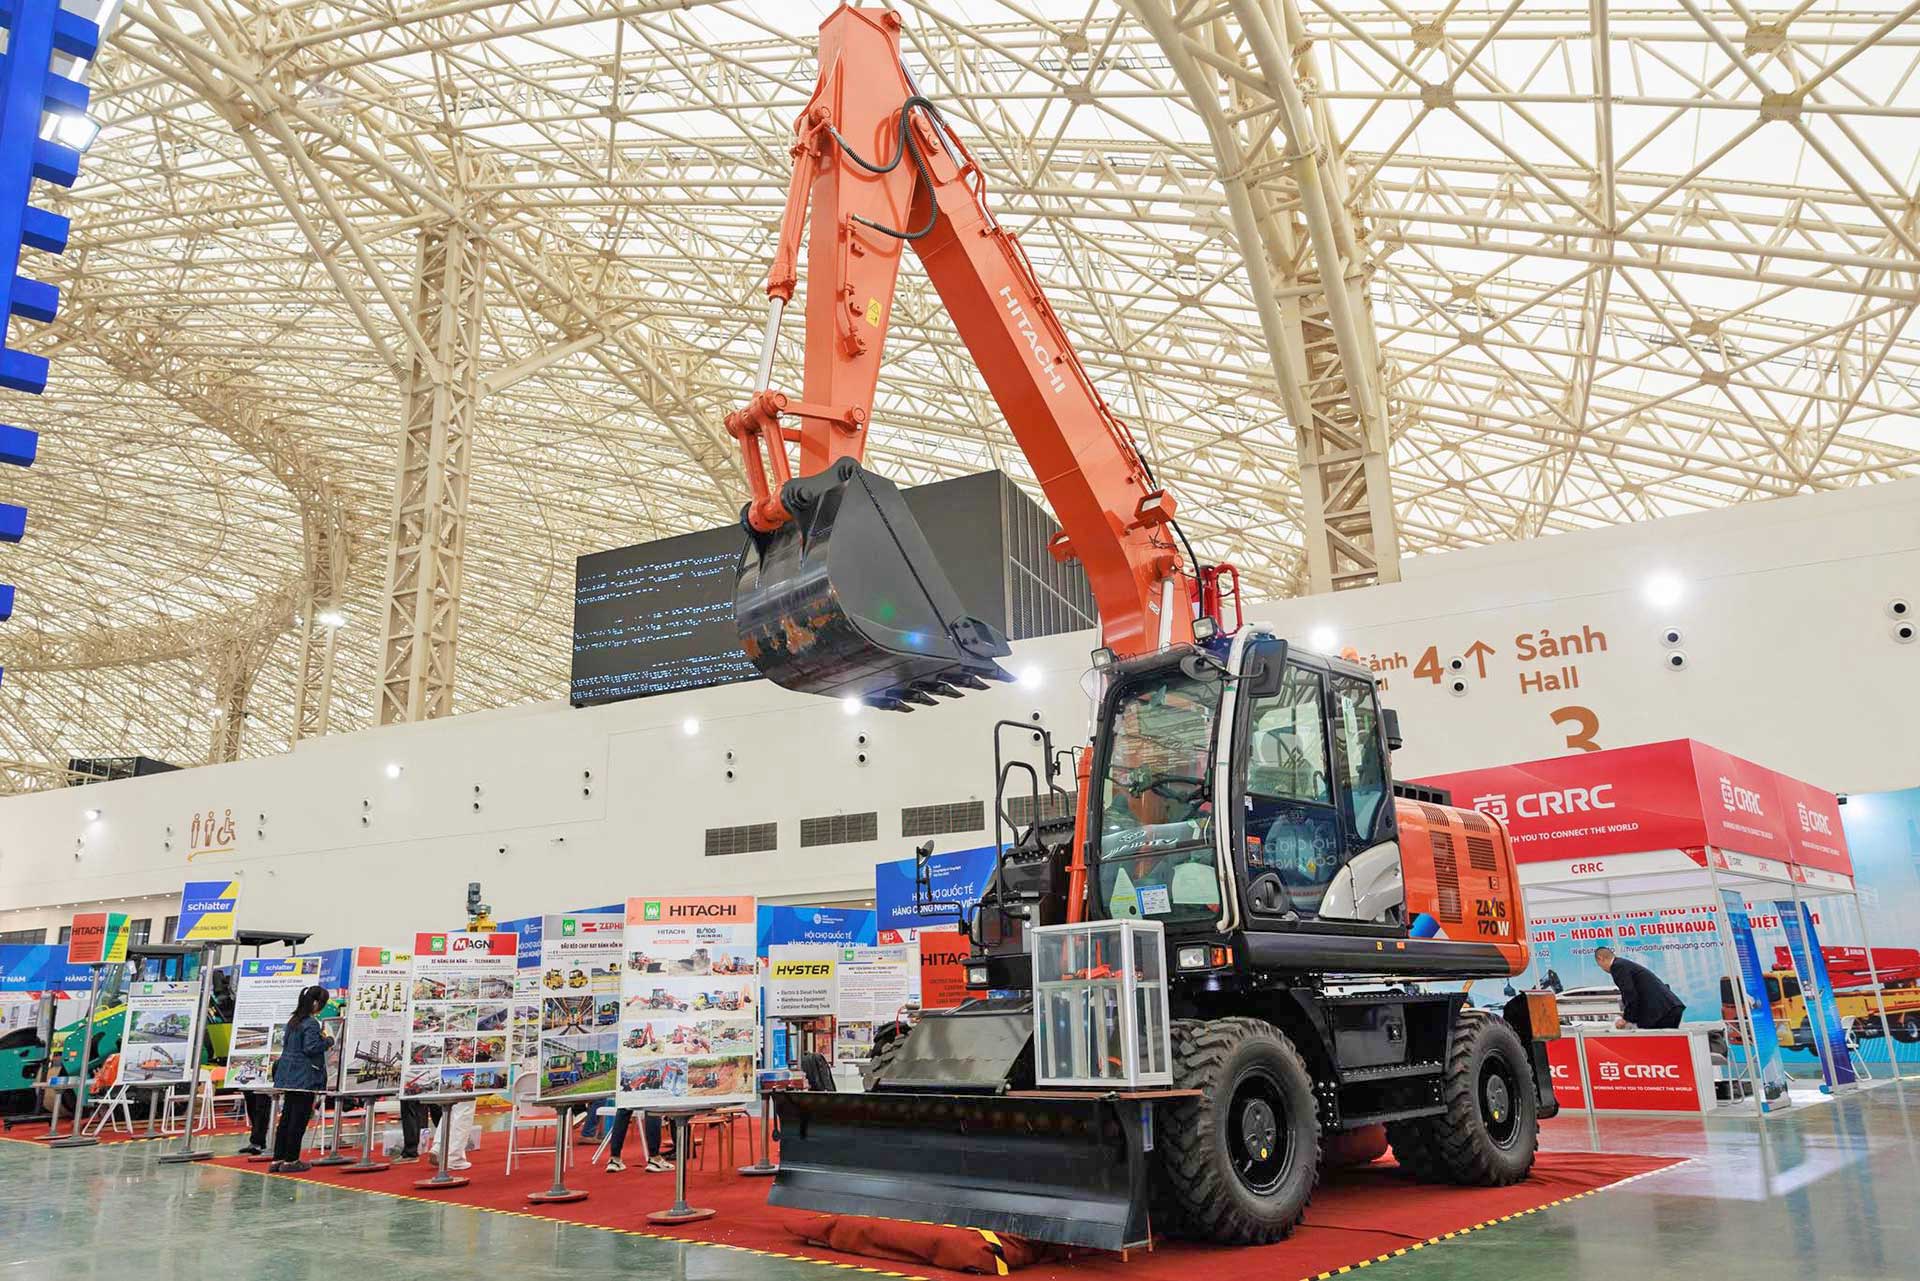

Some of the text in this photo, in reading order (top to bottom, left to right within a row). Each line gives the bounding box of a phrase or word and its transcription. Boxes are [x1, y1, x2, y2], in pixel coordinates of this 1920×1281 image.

[999, 286, 1066, 393] HITACHI
[1515, 624, 1607, 662] Sảnh
[1413, 646, 1444, 684] 4
[1519, 665, 1579, 694] Hall
[1516, 783, 1616, 818] CRRC
[1734, 786, 1764, 816] CRRC
[1521, 833, 1537, 843] YOU
[1538, 832, 1550, 841] TO
[1551, 827, 1589, 839] CONNECT
[1590, 826, 1606, 834] THE
[1607, 822, 1639, 832] WORLD
[1571, 862, 1604, 874] CRRC
[964, 882, 974, 895] TẾ
[187, 902, 230, 911] schlatter
[669, 904, 736, 917] HITACHI
[1476, 896, 1506, 917] ZAXIS
[71, 926, 104, 936] HITACHI
[1478, 920, 1510, 936] 170W
[1571, 926, 1614, 941] KHOAN
[1639, 920, 1717, 936] FURUKAWA
[453, 937, 495, 951] MAGNI
[921, 952, 969, 966] HITAC
[265, 963, 293, 971] schlatter
[776, 965, 830, 976] HYSTER
[1623, 1064, 1680, 1079] CRRC
